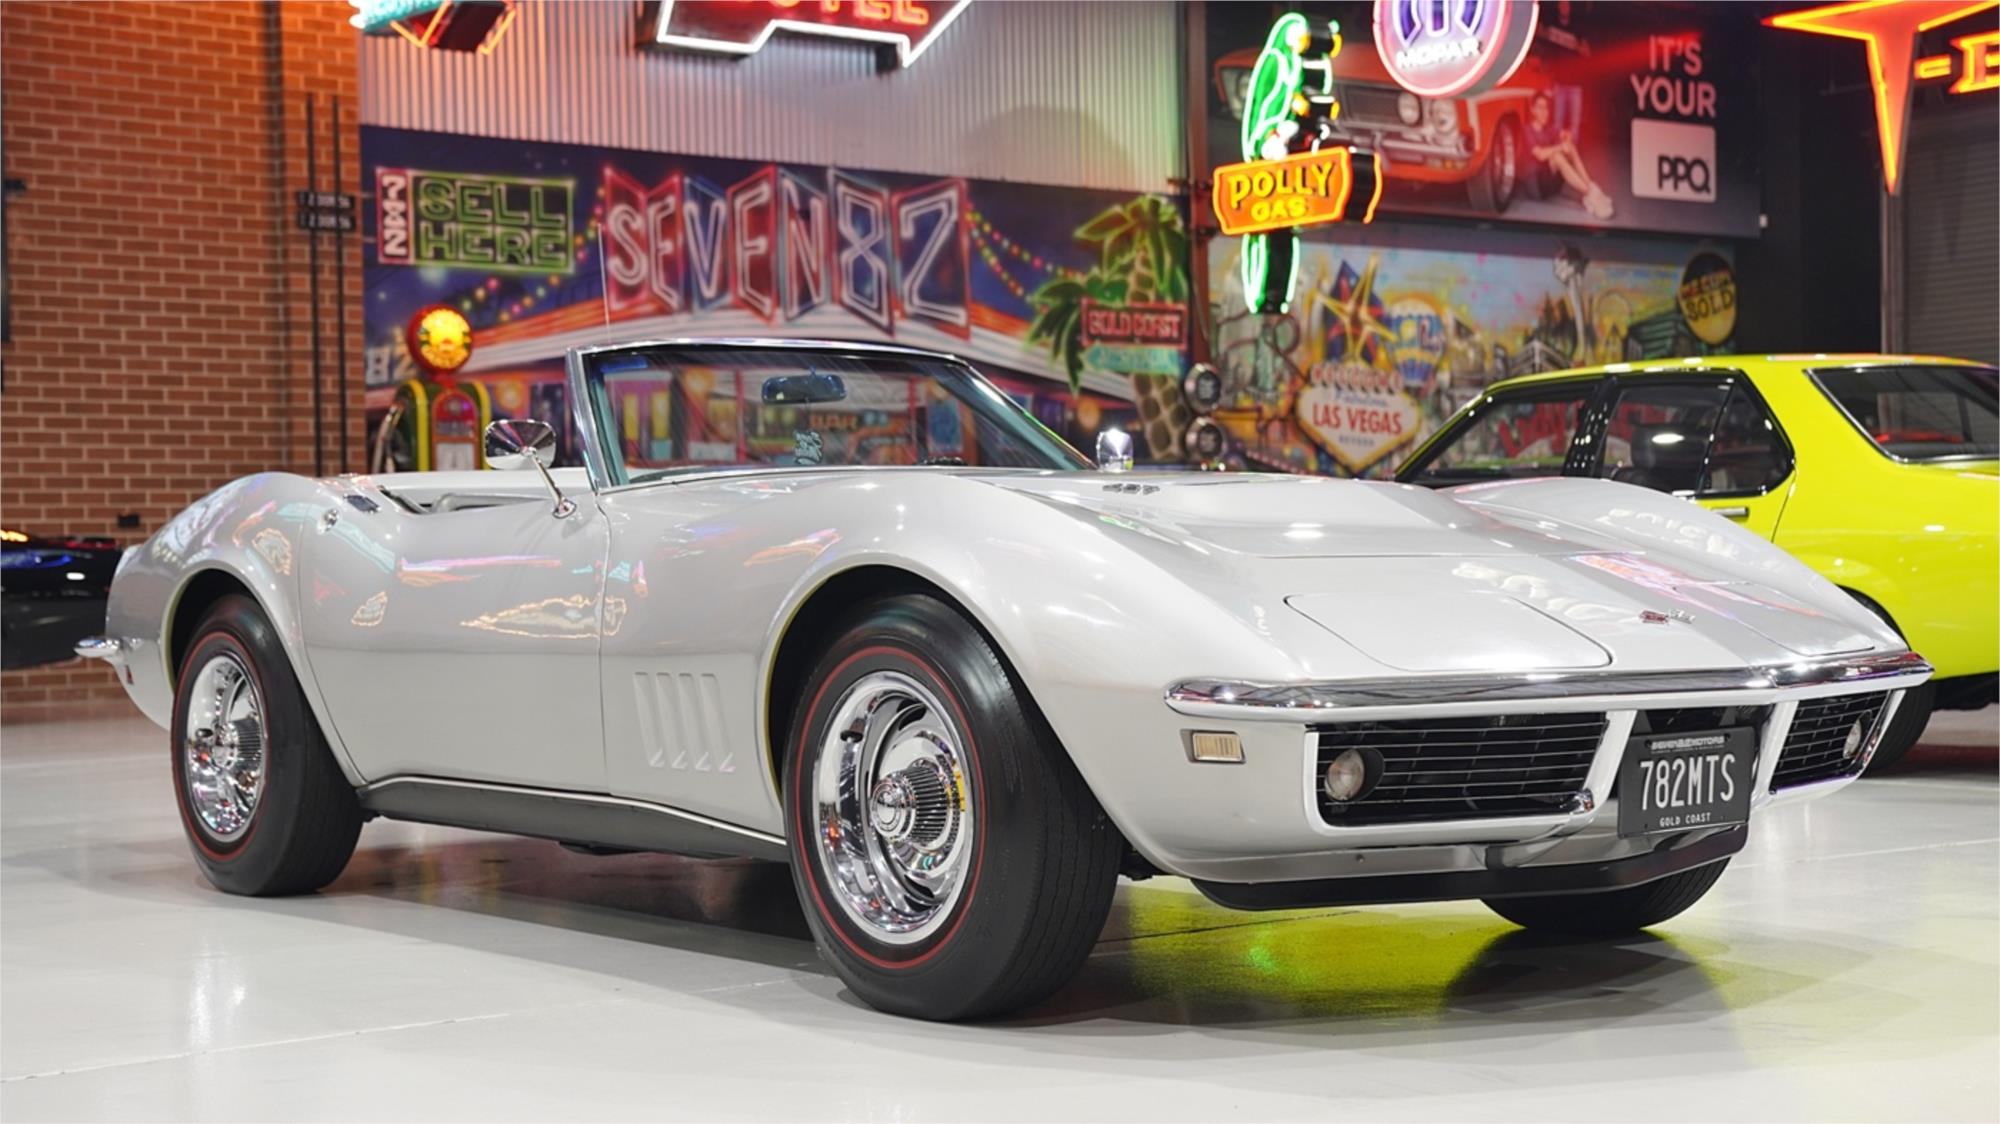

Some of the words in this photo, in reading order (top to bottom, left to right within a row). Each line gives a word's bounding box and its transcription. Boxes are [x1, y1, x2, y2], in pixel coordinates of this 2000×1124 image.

[1395, 37, 1482, 70] MOPAR
[1650, 35, 1702, 76] IT'S
[1630, 73, 1716, 118] YOUR
[1228, 161, 1332, 209] POLLY
[1658, 154, 1711, 194] PPQ
[419, 178, 567, 227] SELL
[1251, 196, 1306, 222] GAS
[420, 221, 567, 267] HERE
[604, 168, 968, 334] SEVEN82
[1088, 309, 1131, 336] GOLD
[1132, 312, 1179, 339] COAST
[1313, 402, 1342, 429] LAS
[1346, 407, 1403, 436] VEGAS
[1640, 753, 1736, 811] 782MTS
[1659, 814, 1681, 828] GOLD
[1685, 812, 1712, 825] COAST
